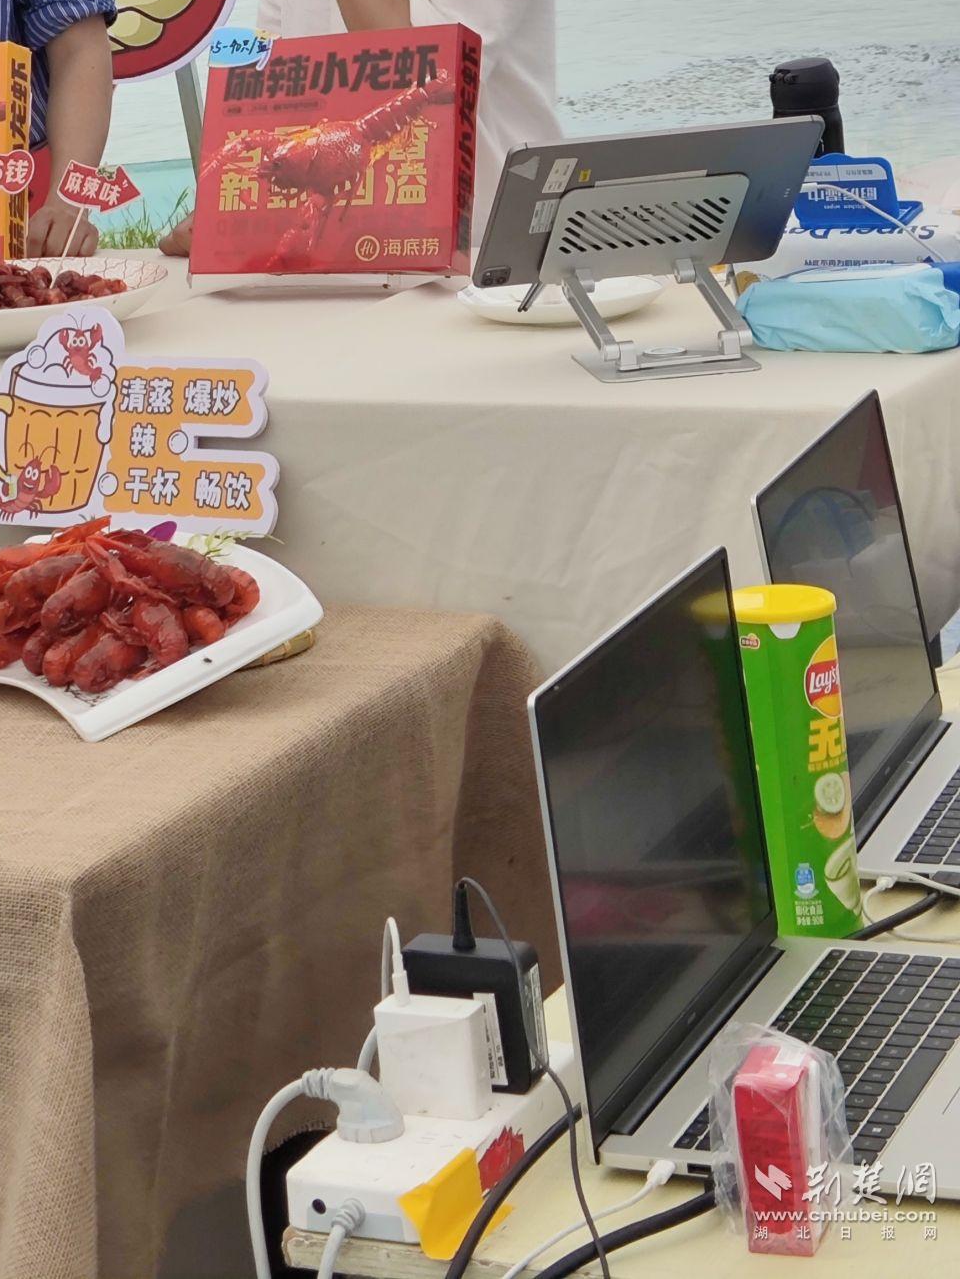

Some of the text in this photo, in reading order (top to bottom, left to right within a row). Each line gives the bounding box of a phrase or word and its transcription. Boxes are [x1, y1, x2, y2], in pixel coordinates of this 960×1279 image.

[224, 43, 439, 102] 麻辣小龙虾
[64, 170, 123, 206] 麻辣味
[383, 237, 440, 257] 海底捞
[120, 377, 241, 416] 清蒸 爆炒
[129, 423, 156, 457] 辣
[124, 467, 252, 510] 干杯 畅饮
